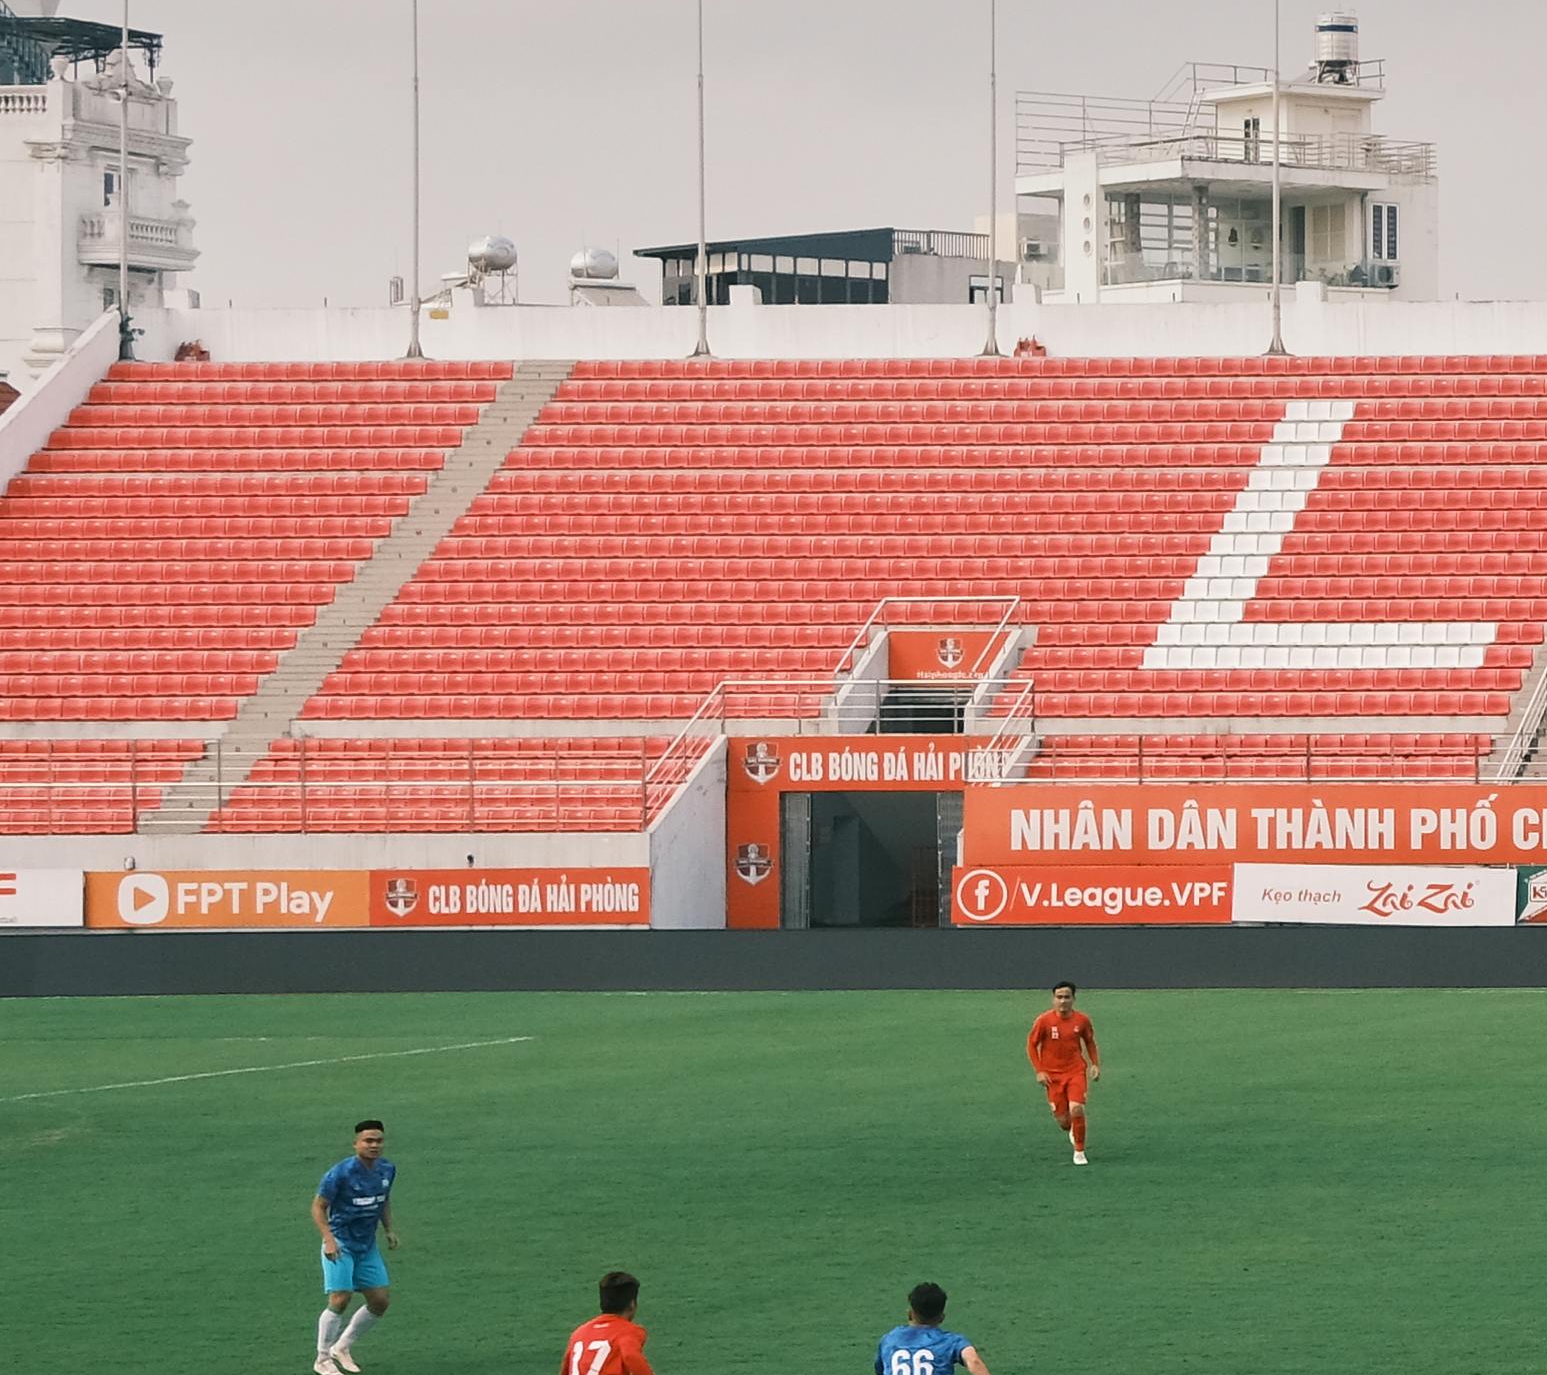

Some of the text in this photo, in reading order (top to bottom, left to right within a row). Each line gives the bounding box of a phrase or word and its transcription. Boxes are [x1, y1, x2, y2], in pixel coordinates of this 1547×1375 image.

[790, 753, 823, 781] CLB
[829, 747, 878, 781] BÓNG
[883, 747, 908, 780] ĐÁ
[914, 743, 943, 780] HẢI
[1011, 799, 1132, 850] NHÂN
[1148, 799, 1236, 849] DÂN
[1251, 799, 1394, 849] THÀNH
[1411, 794, 1498, 849] PHỐ
[177, 882, 333, 922] FPT Play
[429, 875, 639, 913] CLB BÓNG ĐÁ HẢI PHÒNG
[1021, 882, 1227, 914] V.League.VPF
[1262, 888, 1342, 906] Kẹo thạch
